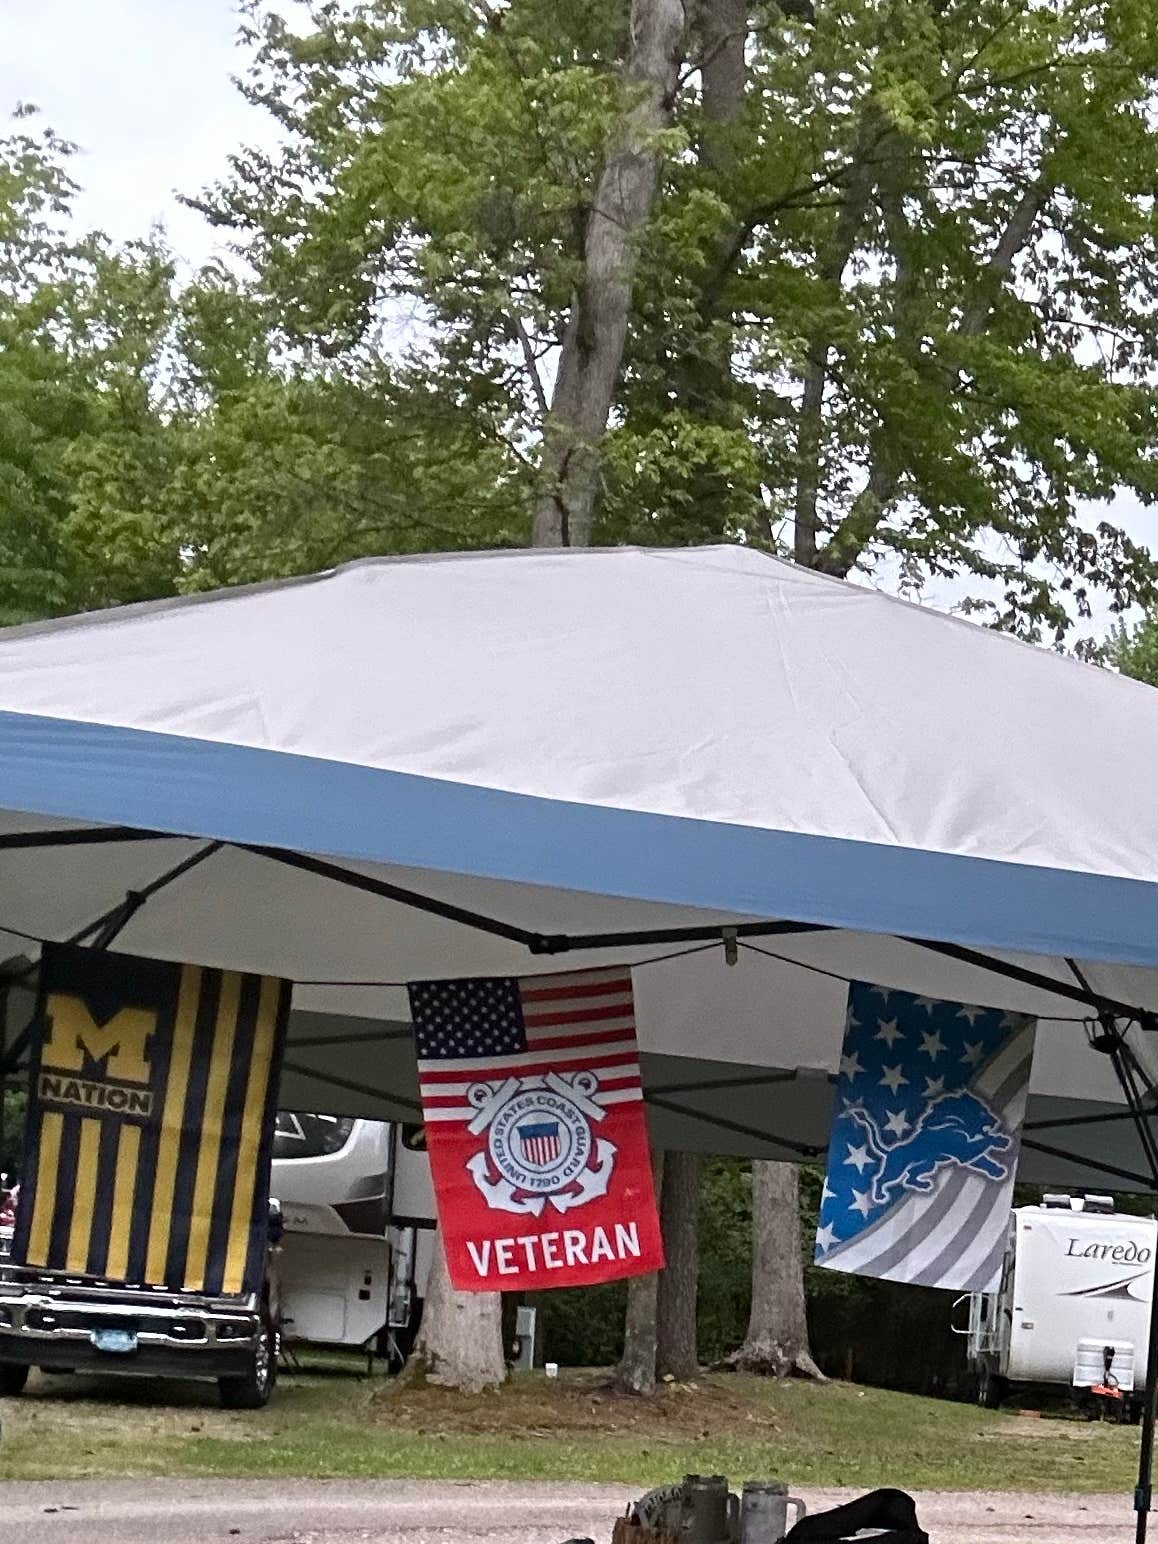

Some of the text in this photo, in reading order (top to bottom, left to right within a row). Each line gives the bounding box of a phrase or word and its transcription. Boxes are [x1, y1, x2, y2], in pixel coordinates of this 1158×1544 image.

[41, 994, 158, 1084] M
[41, 1077, 151, 1113] NATION
[493, 1095, 586, 1184] UNITED STATES COAST GUARD
[529, 1175, 561, 1188] 1790
[466, 1221, 641, 1277] VETERAN
[1064, 1238, 1151, 1263] Laredo
